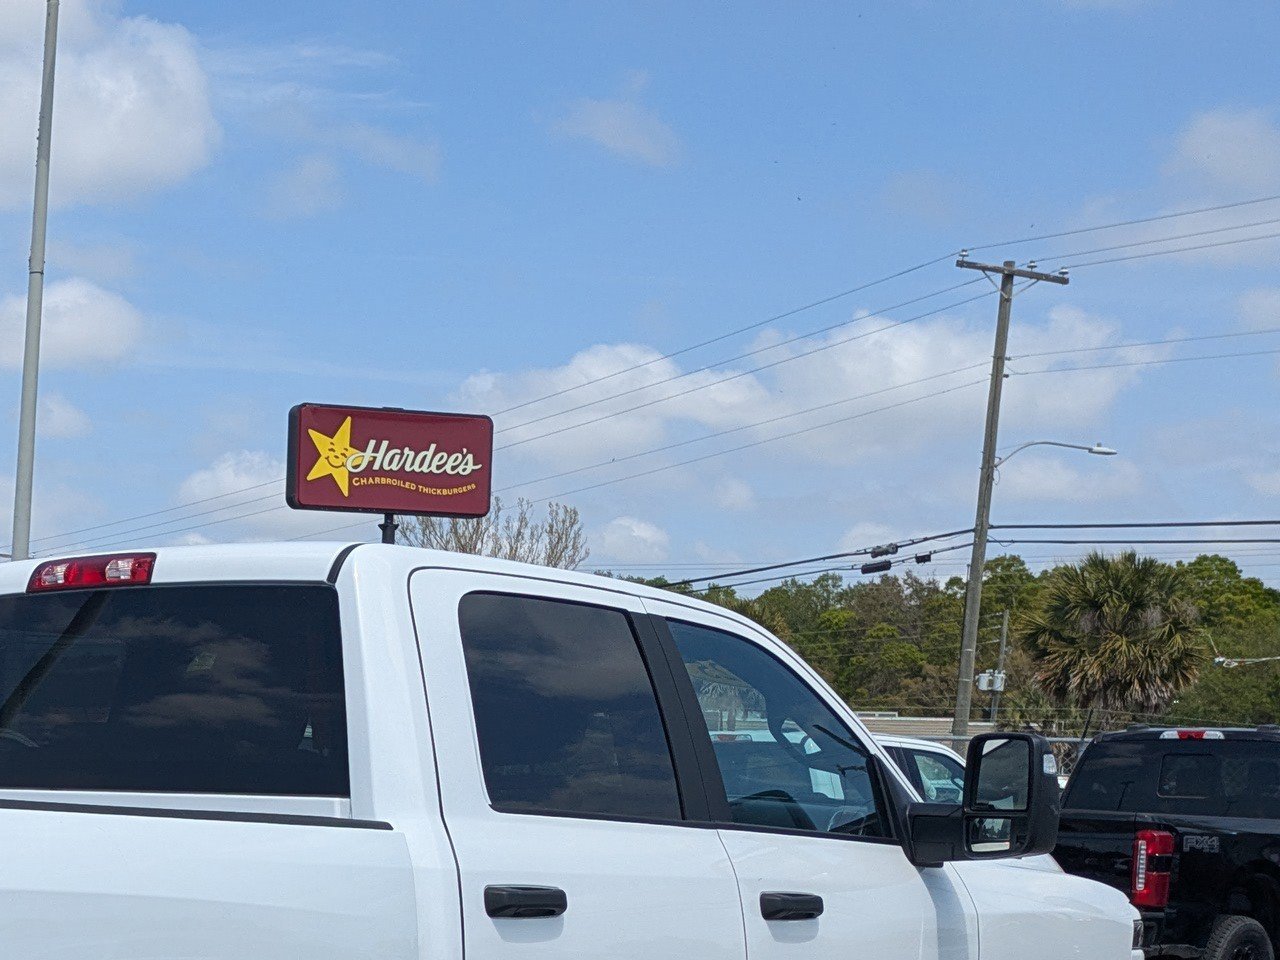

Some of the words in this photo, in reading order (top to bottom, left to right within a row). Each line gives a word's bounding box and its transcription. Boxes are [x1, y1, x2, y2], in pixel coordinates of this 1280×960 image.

[345, 439, 482, 476] Hardee's
[352, 477, 416, 490] CHARBROILED
[418, 483, 476, 496] THICKBURGERS
[1183, 835, 1220, 852] FX4
